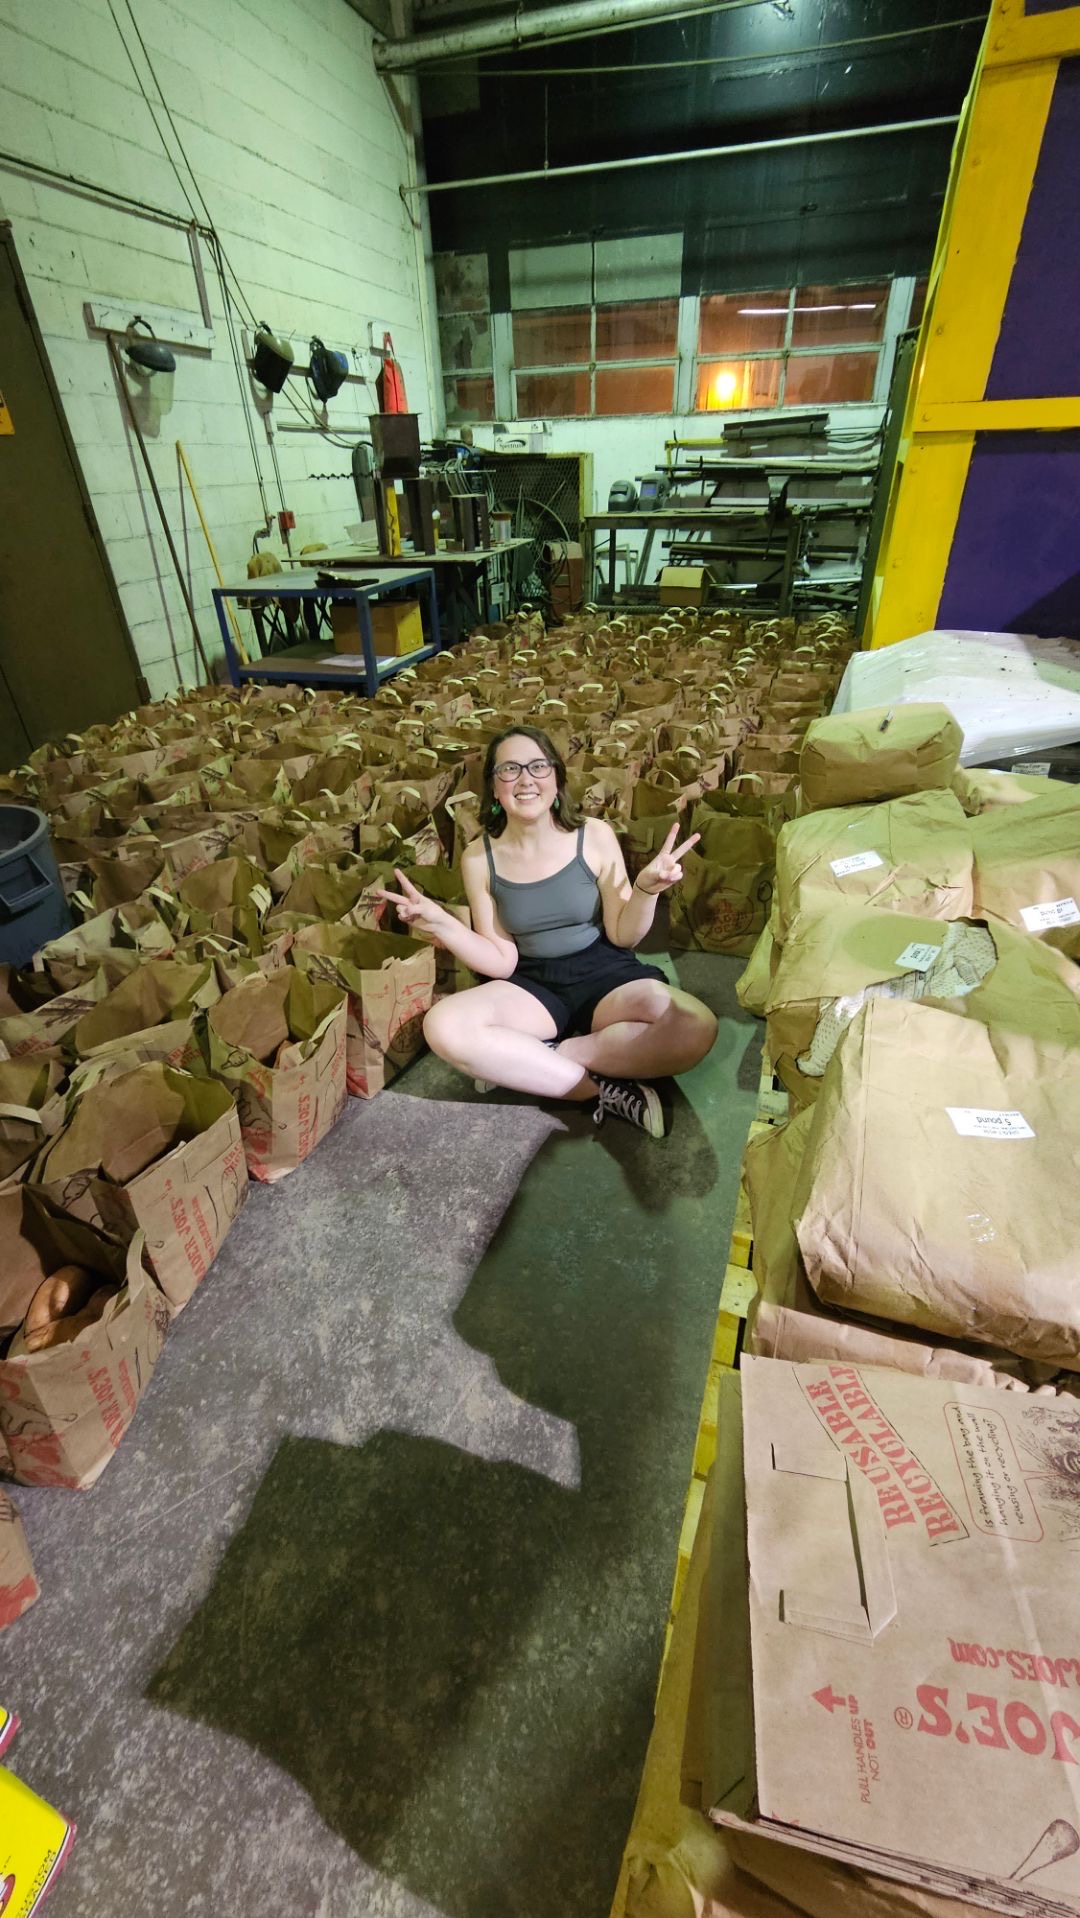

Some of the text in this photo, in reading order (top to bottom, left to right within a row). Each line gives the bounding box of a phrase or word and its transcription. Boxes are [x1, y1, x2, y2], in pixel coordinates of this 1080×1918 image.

[952, 1406, 964, 1426] and
[960, 1428, 971, 1447] bag
[806, 1380, 917, 1530] REUSABLE
[966, 1450, 977, 1469] the
[966, 1412, 1009, 1526] hanging it on the wall
[982, 1417, 1024, 1525] reusing or recycling?
[973, 1472, 990, 1516] framing
[848, 1694, 872, 1805] PULL HANDLES UP
[863, 1719, 880, 1781] NOT OUT
